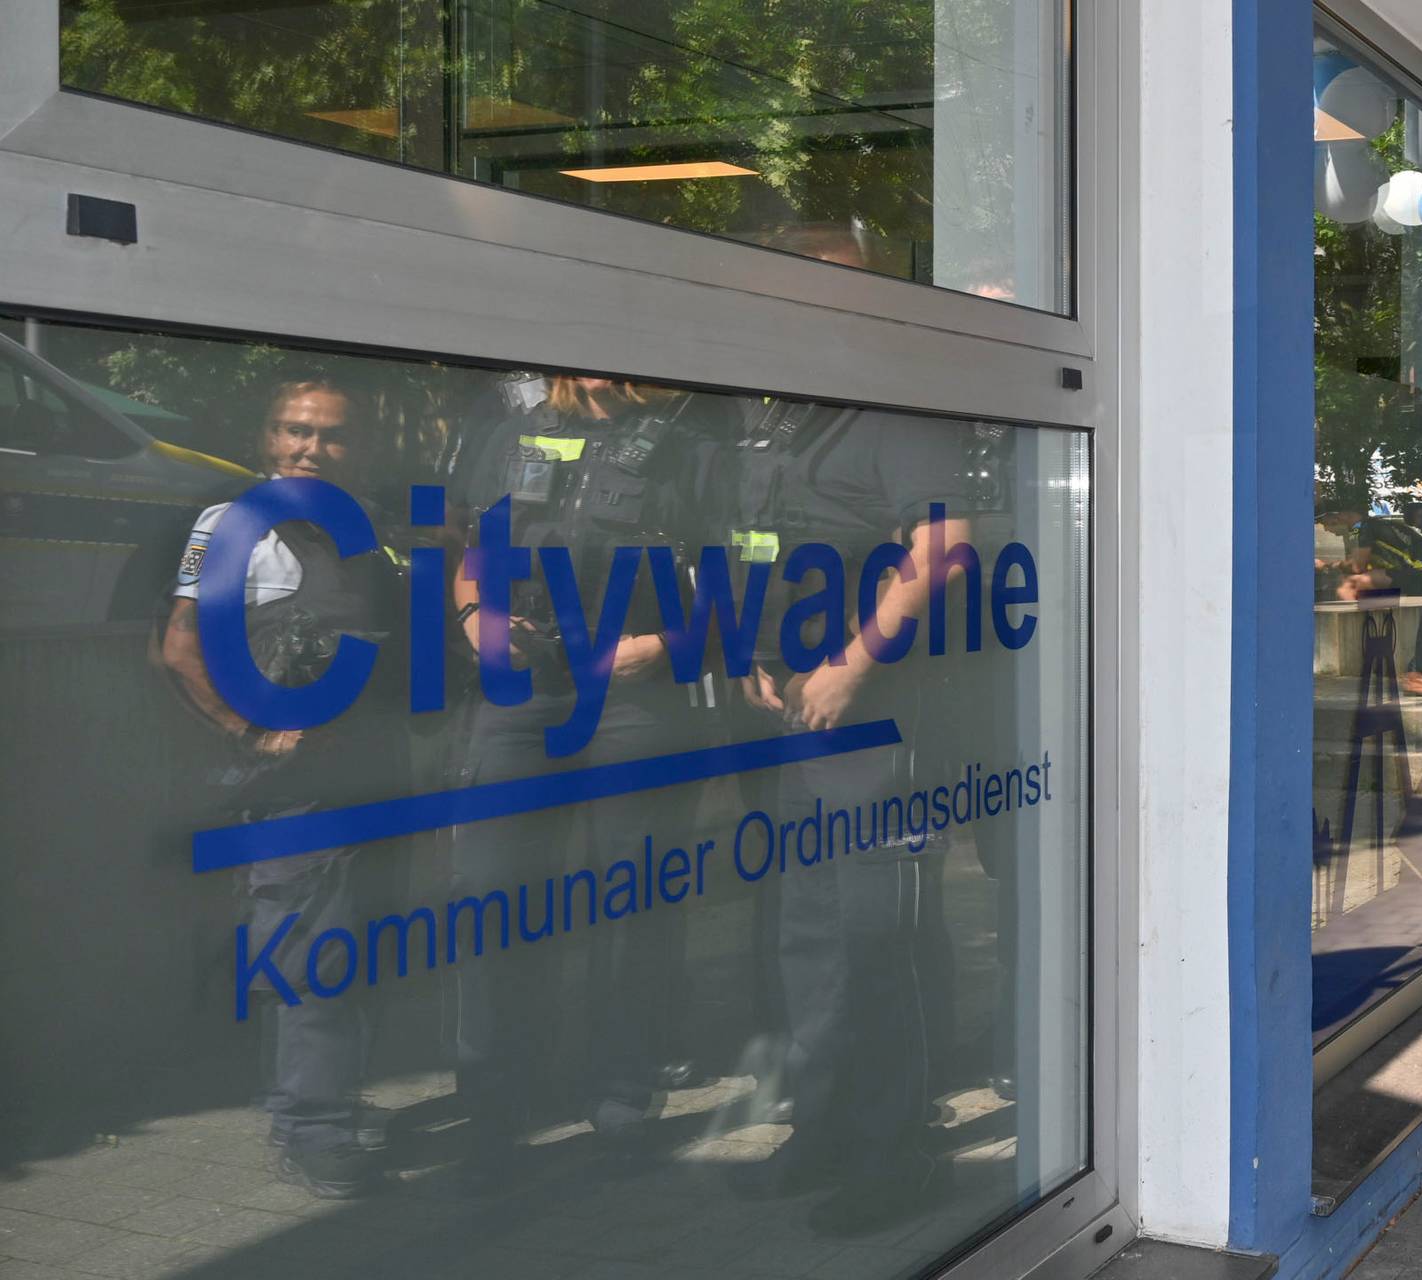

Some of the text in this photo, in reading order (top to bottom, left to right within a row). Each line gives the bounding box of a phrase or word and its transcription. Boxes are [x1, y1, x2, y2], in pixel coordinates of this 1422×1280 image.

[197, 478, 1039, 758] Citywache
[235, 750, 1053, 1021] Kommunaler Ordnungsdienst
